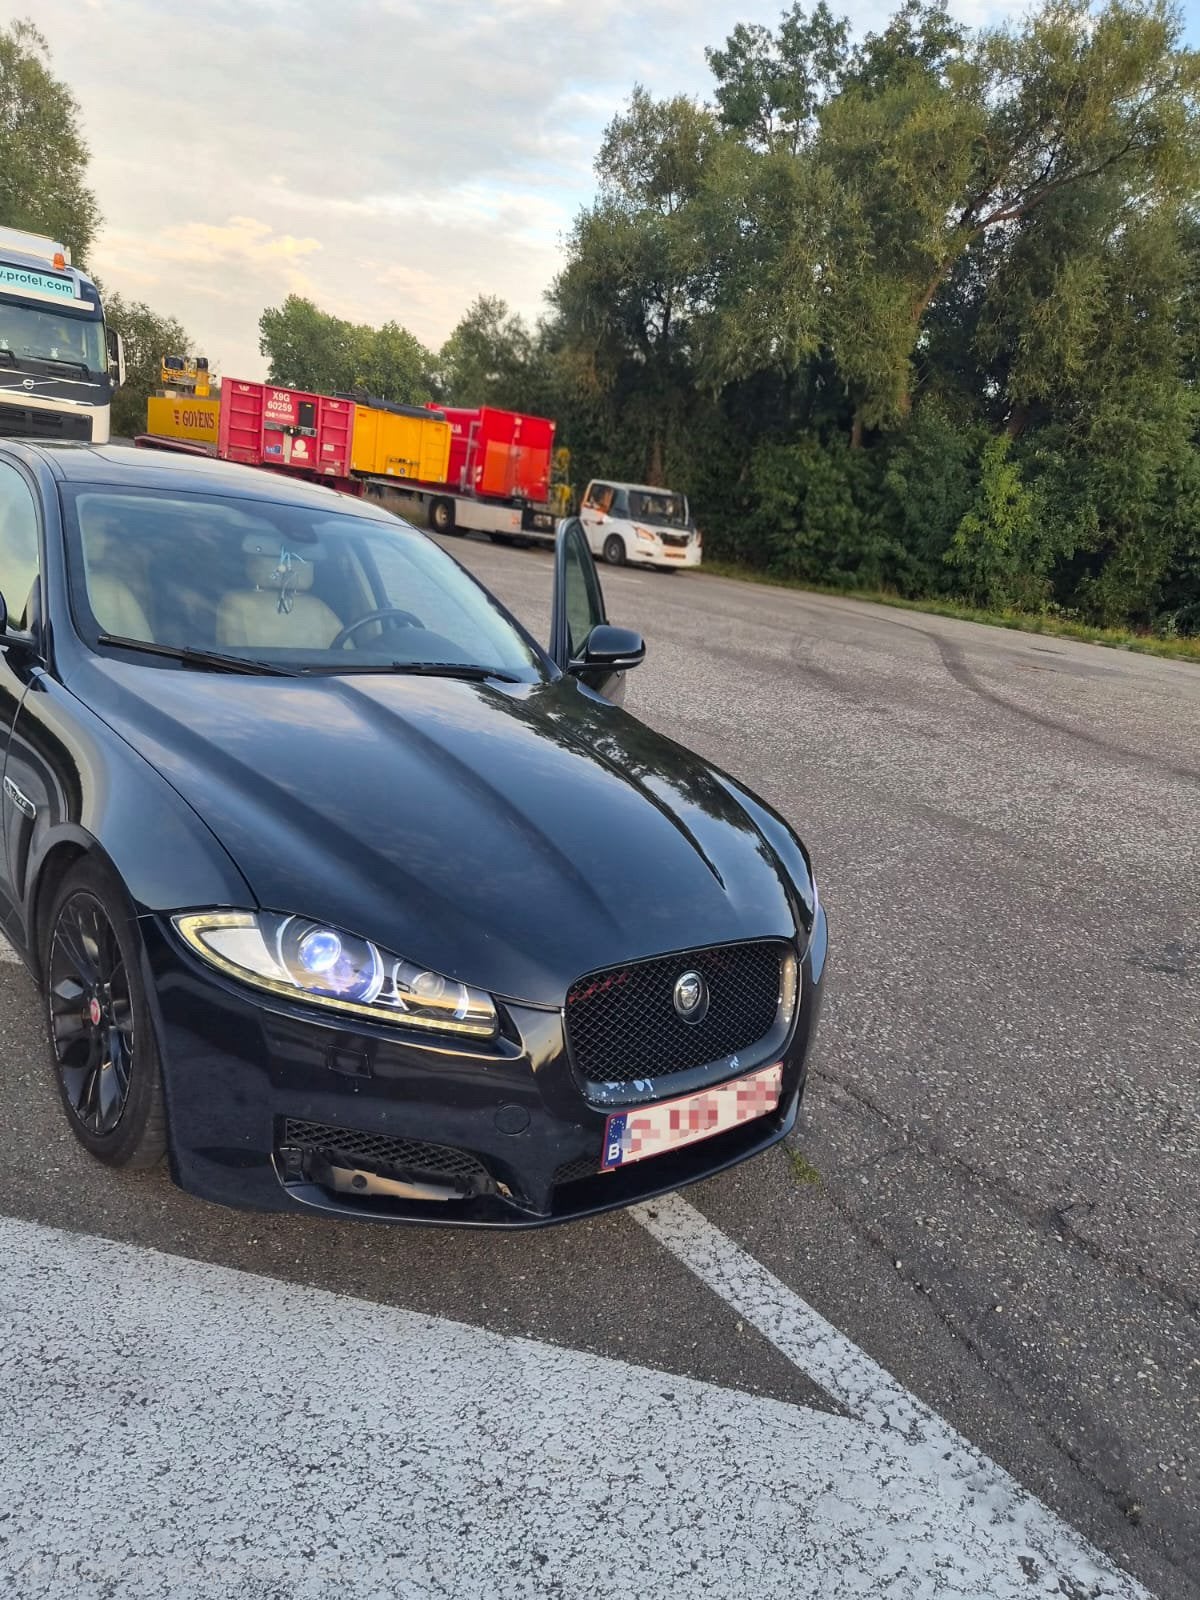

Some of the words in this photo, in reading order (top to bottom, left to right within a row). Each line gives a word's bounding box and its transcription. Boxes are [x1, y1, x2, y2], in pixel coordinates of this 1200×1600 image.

[272, 391, 291, 402] X9G
[267, 400, 293, 413] 60259
[182, 410, 215, 429] GOYENS
[608, 1142, 620, 1161] B
